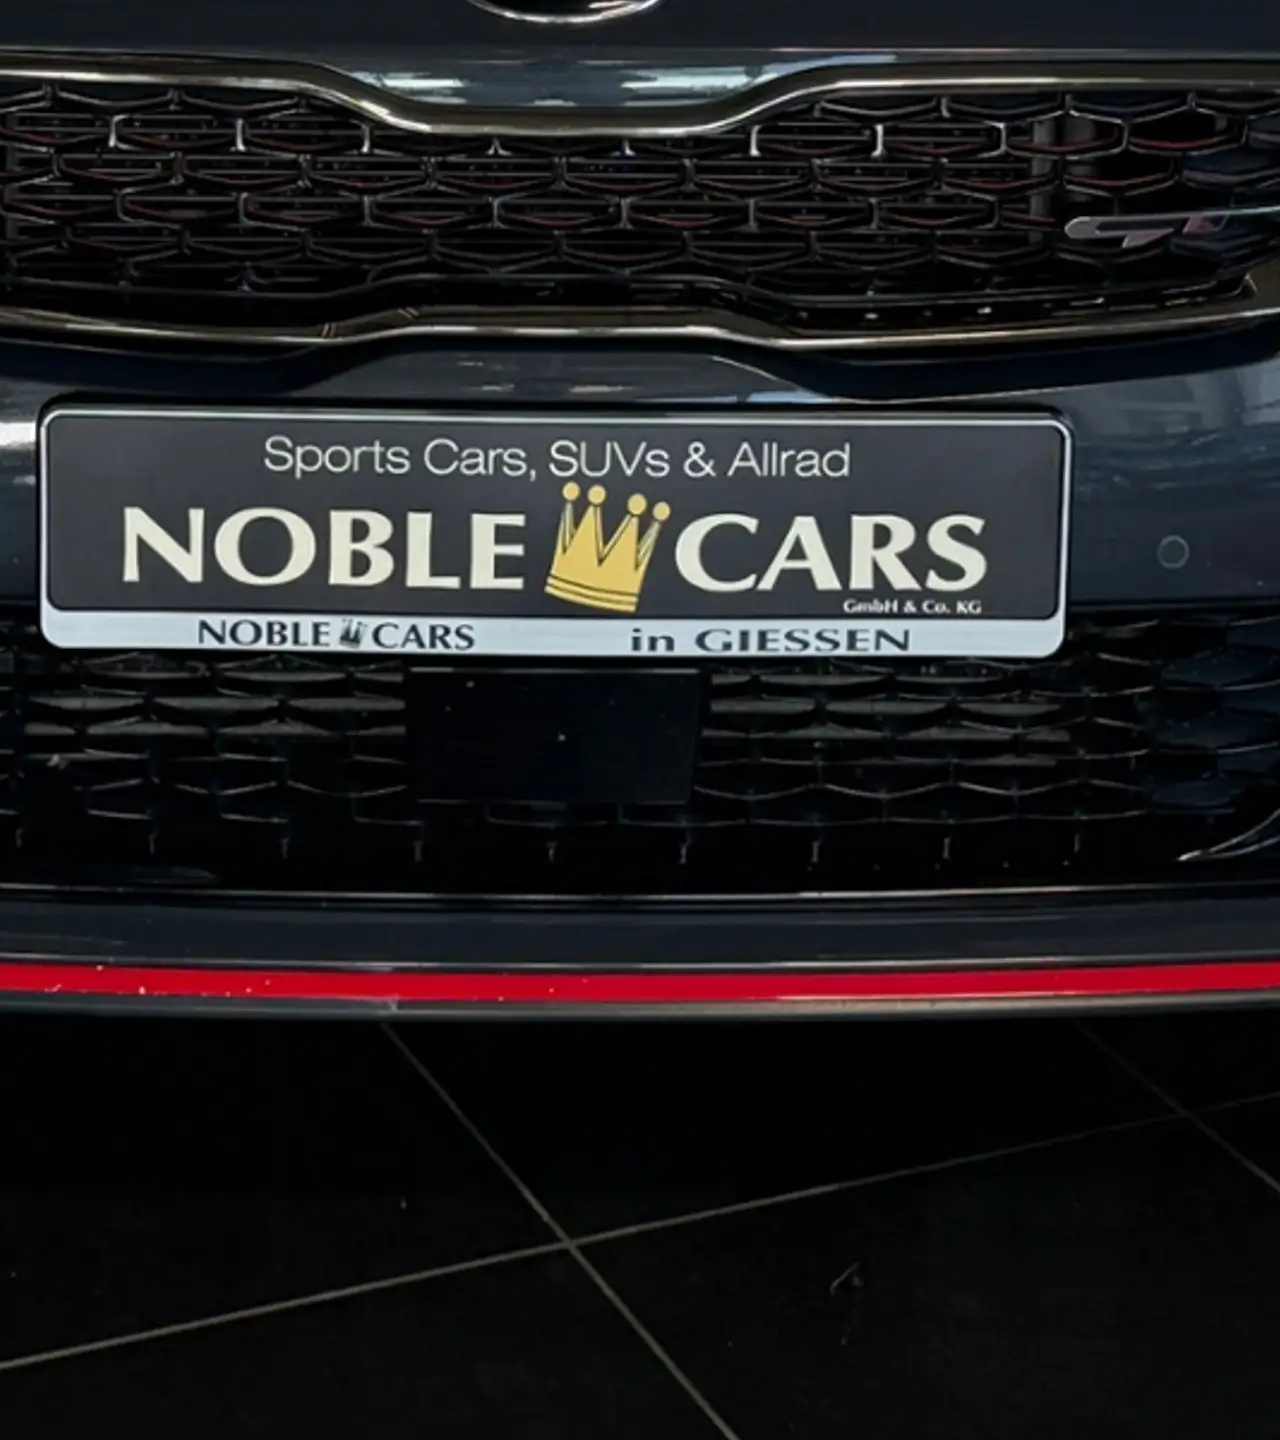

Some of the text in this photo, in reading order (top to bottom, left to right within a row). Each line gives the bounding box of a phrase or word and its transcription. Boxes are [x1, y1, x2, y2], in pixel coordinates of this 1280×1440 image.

[263, 436, 851, 482] Sports Cars, SUVs & Allrad
[120, 505, 990, 593] NOBLE CARS
[842, 598, 982, 615] GmbH & Co. KG
[197, 618, 911, 653] NOBLE CARS in GIESSEN
